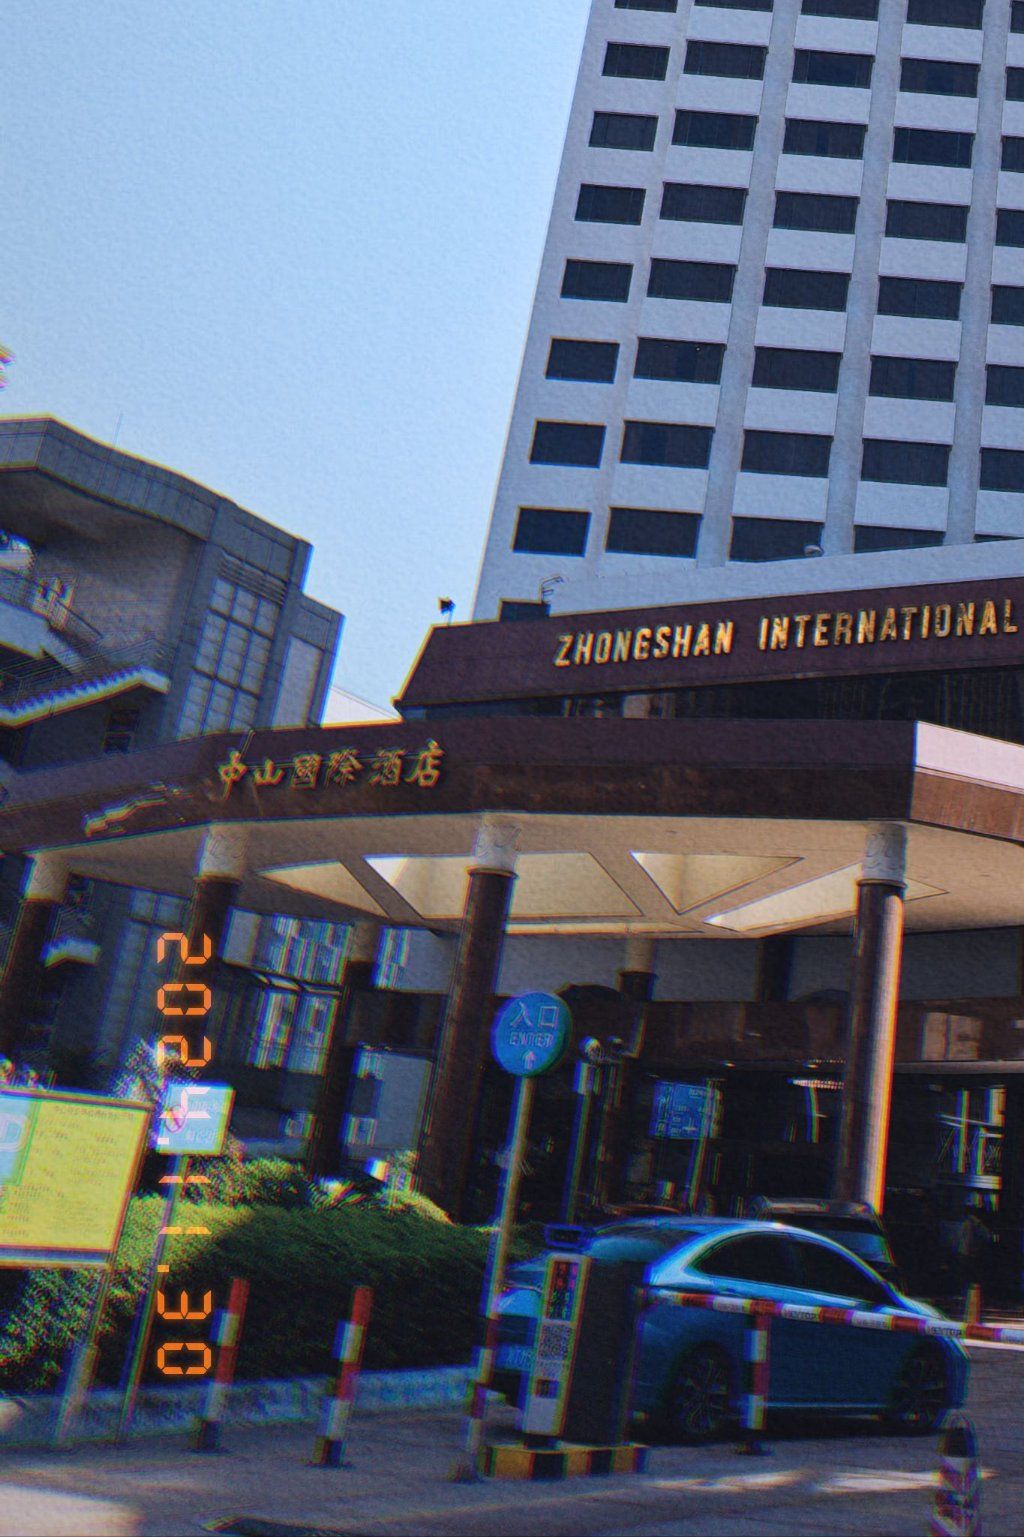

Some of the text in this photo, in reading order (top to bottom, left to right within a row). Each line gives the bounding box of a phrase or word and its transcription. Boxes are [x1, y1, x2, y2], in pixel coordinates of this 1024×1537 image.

[555, 620, 733, 667] ZHONGSHAN
[759, 599, 1018, 650] INTERNATIONAL
[218, 740, 445, 801] 中山國際酒店
[510, 1001, 559, 1028] 入口
[510, 1031, 555, 1048] ENTER
